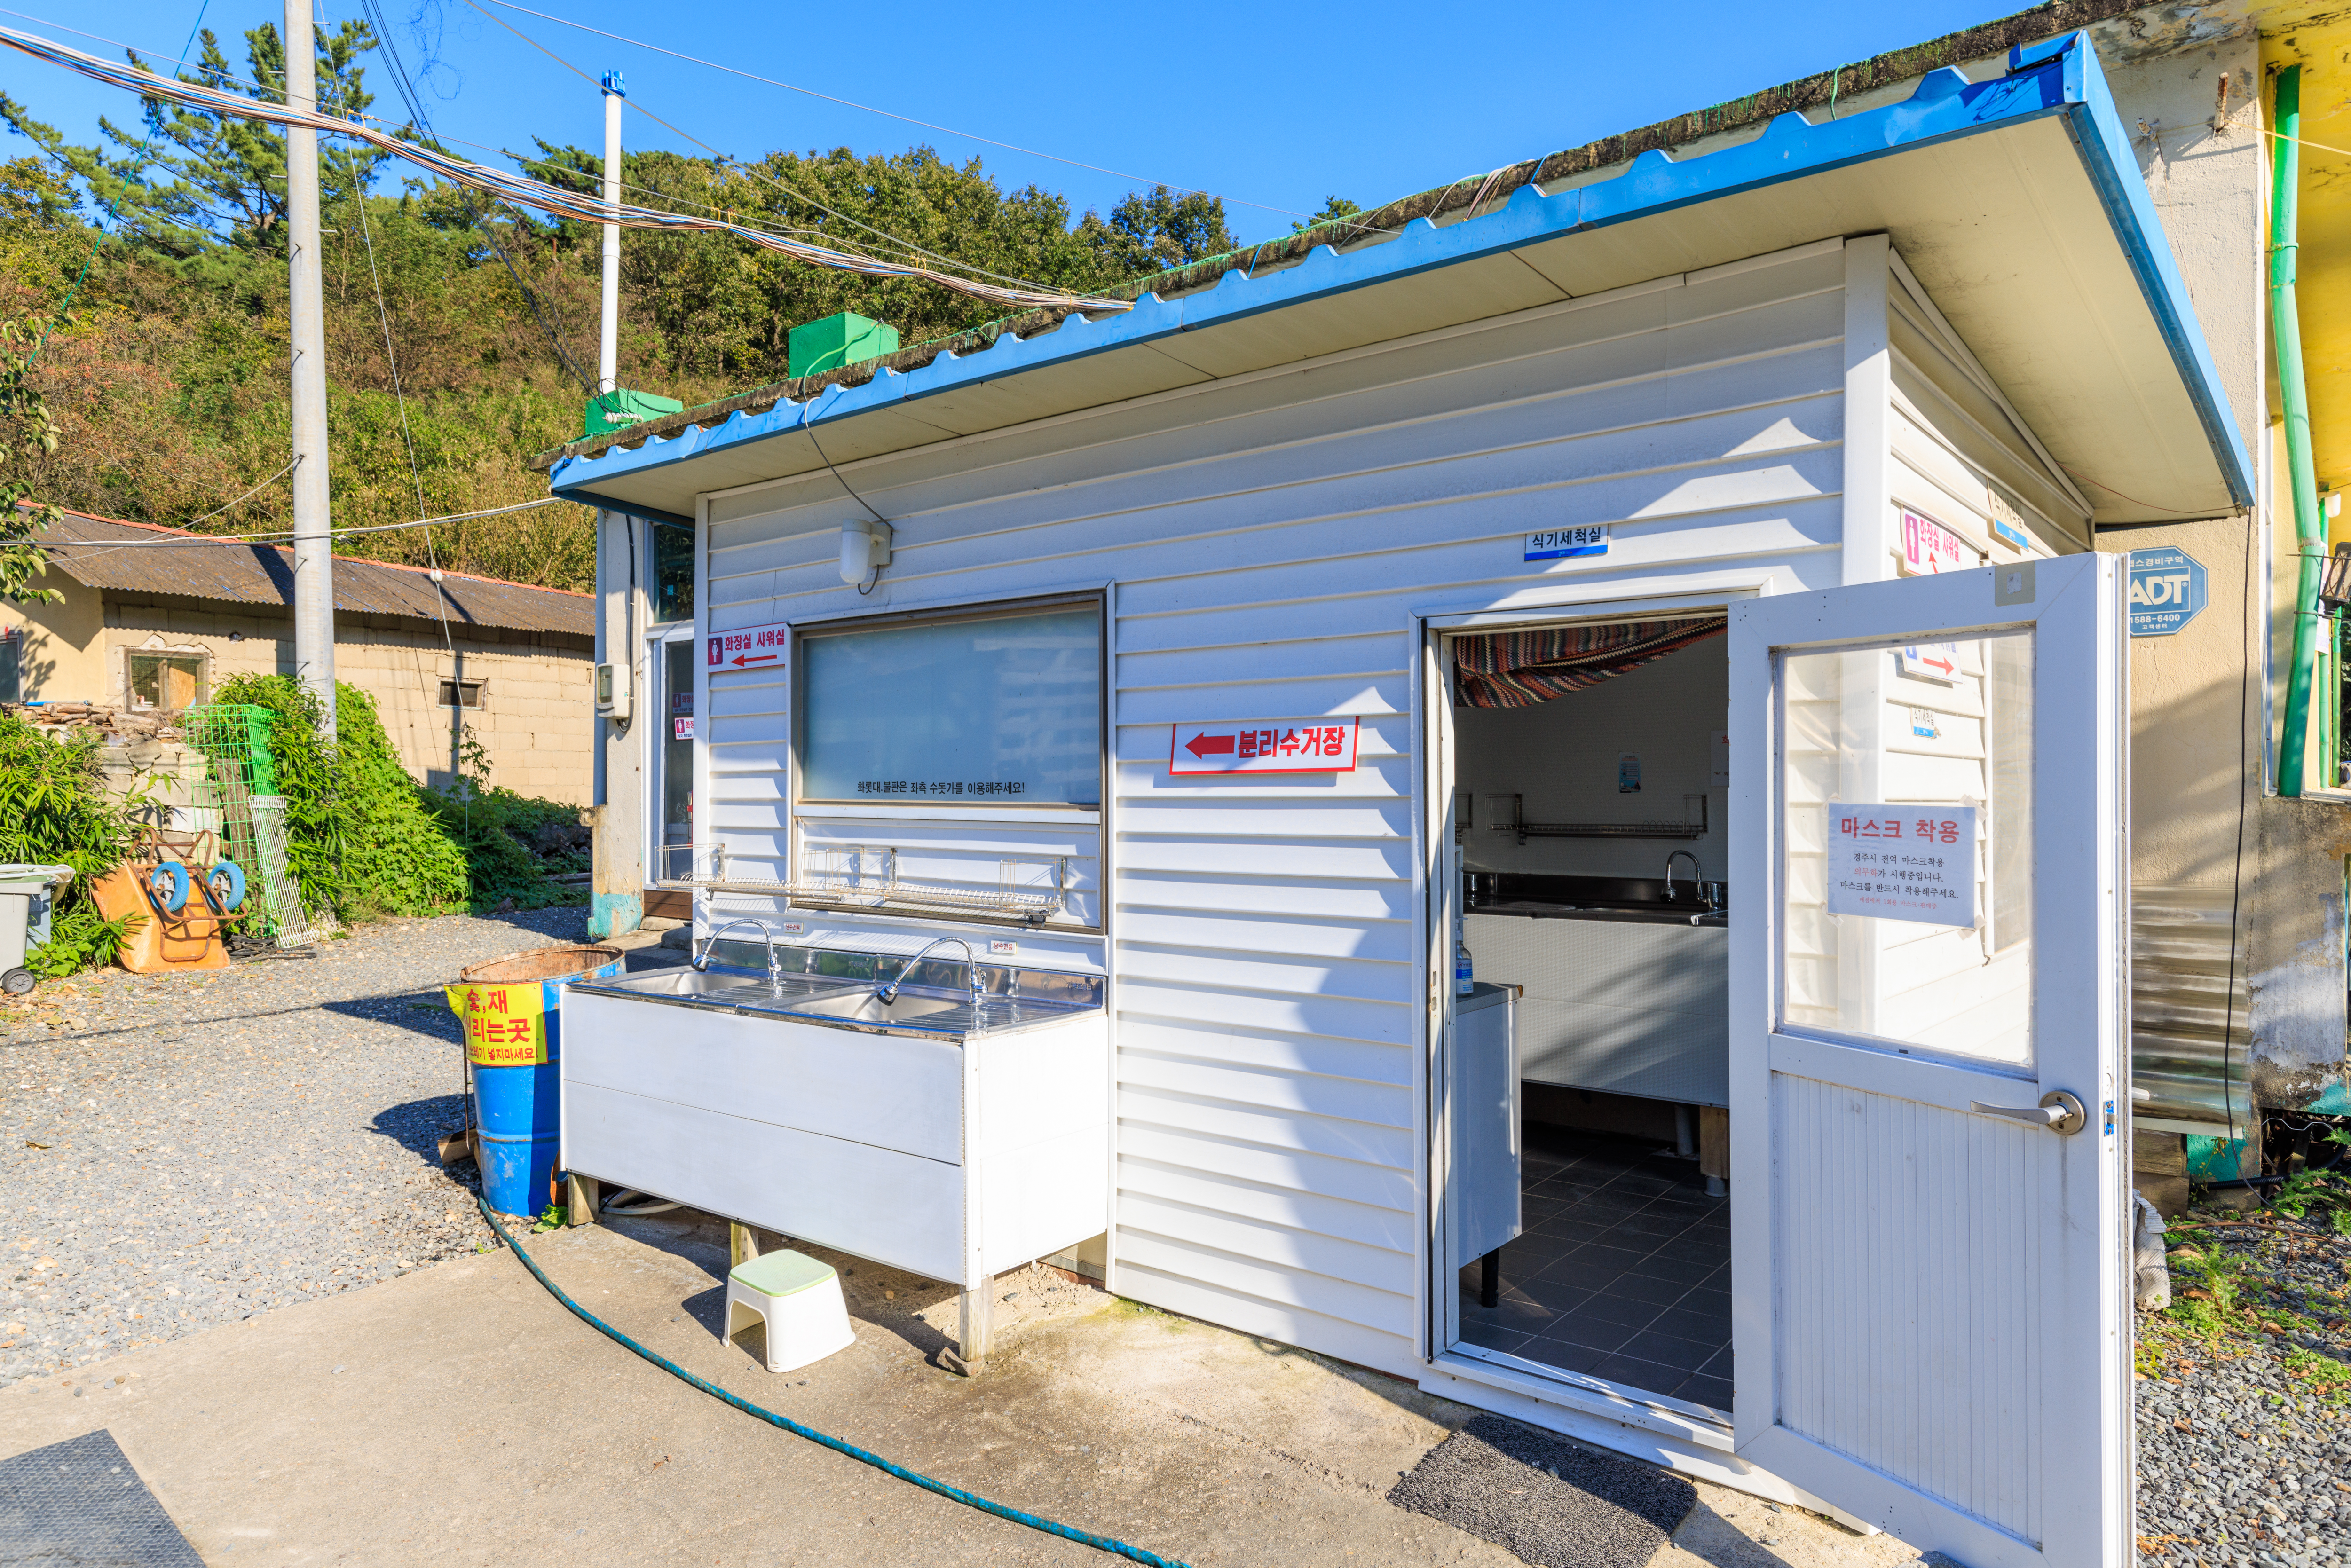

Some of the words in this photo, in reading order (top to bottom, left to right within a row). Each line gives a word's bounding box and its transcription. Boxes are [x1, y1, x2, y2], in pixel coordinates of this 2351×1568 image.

[1994, 489, 2023, 529] 식기세척실
[1532, 527, 1601, 548] 식기세척실
[1920, 519, 1939, 552] 화장실
[1943, 532, 1959, 562] 샤워실
[2130, 574, 2189, 606] ADT
[2130, 614, 2180, 623] 1588-6400
[725, 633, 751, 651] 화장실
[757, 629, 784, 647] 샤워실
[1238, 726, 1345, 758] 분리수거장
[858, 781, 907, 794] 화롯대.불판은
[910, 782, 926, 794] 좌측
[929, 782, 963, 795] 수돗가를
[968, 781, 1025, 795] 이용해주세요!
[1841, 817, 1902, 838] 마스크
[1916, 819, 1959, 843] 착용
[1854, 853, 1876, 863] 경주시
[1881, 855, 1897, 864] 전역
[1902, 856, 1944, 867] 마스크착용
[1854, 867, 1886, 878] 의무화가
[1890, 870, 1943, 882] 시행중입니다.
[1840, 881, 1871, 891] 마스크를
[1876, 884, 1899, 894] 반드시
[1905, 886, 1958, 898] 착용해주세요.
[467, 989, 508, 1014] 숯,재
[488, 1047, 538, 1061] 넣지마세요!
